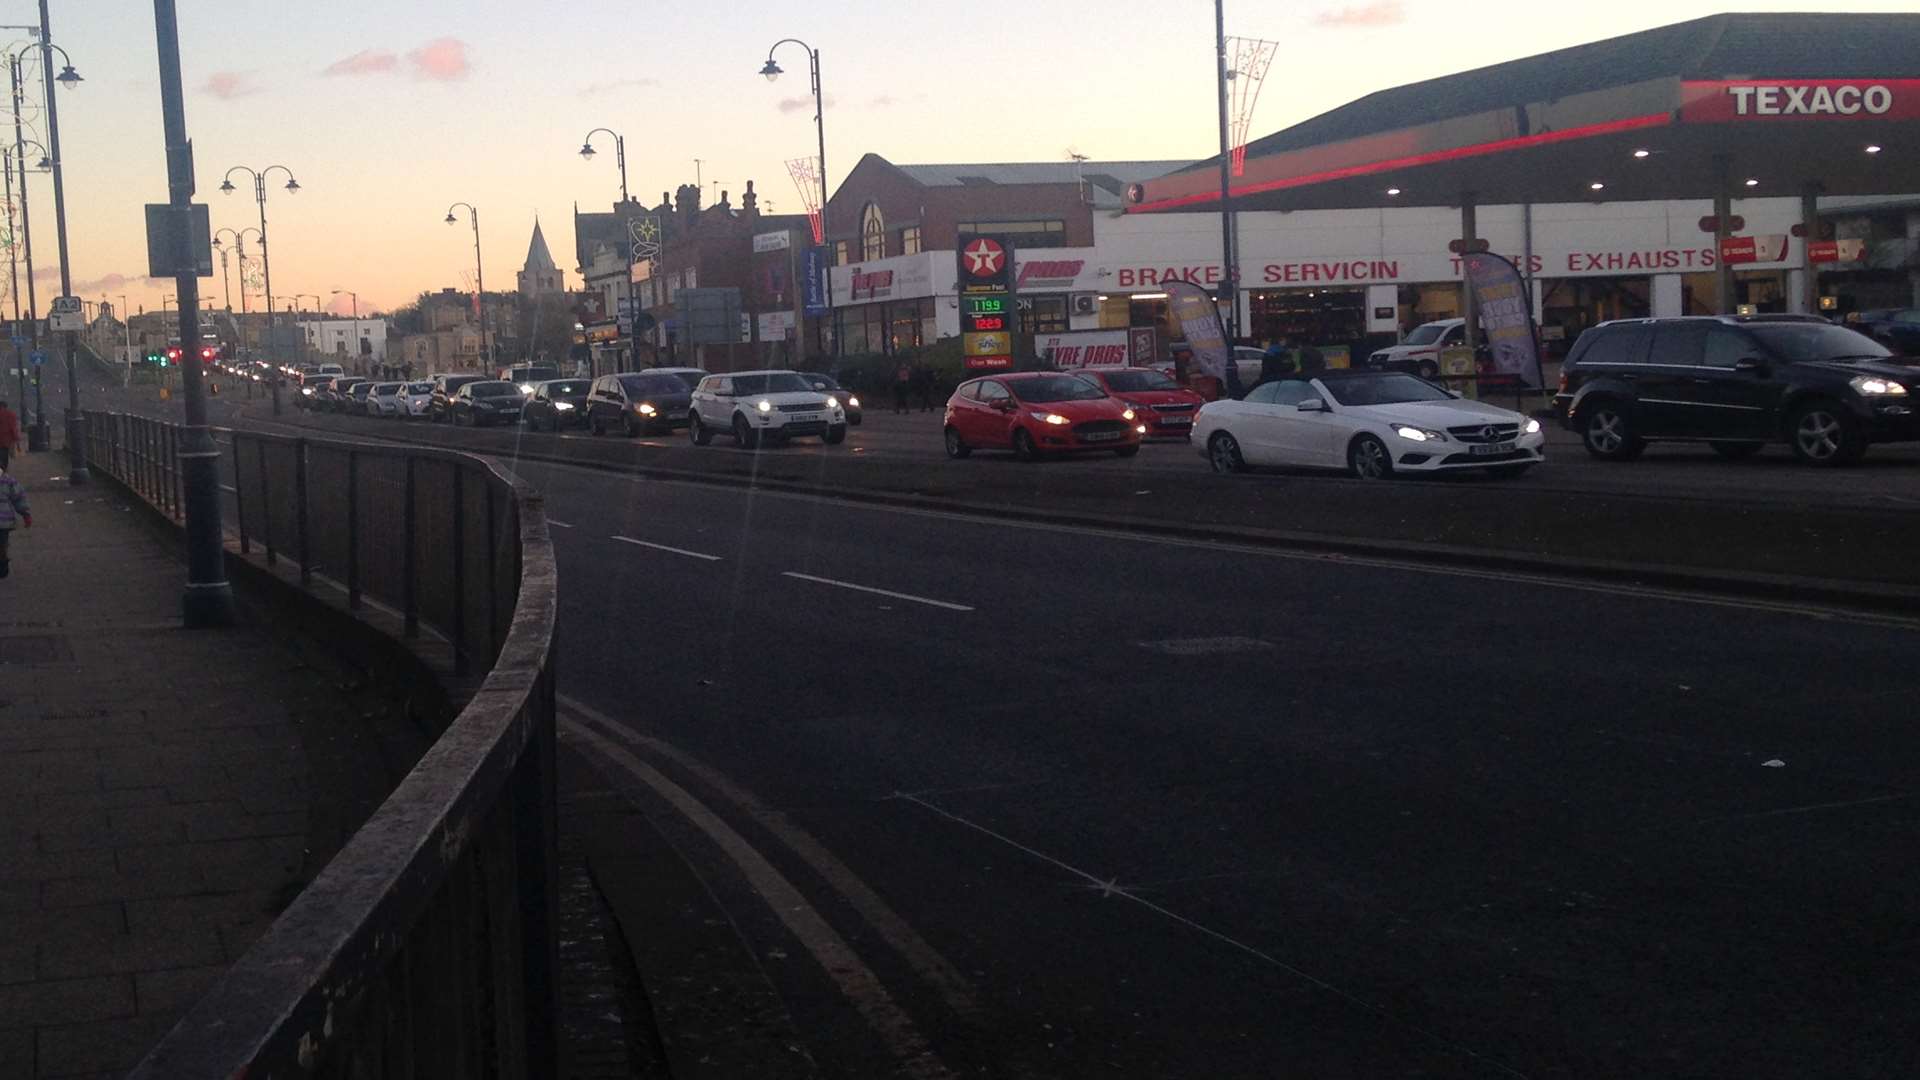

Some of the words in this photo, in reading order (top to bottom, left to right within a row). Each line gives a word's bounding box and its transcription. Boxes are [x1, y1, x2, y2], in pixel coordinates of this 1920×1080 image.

[1728, 85, 1892, 115] TEXACO
[1568, 249, 1715, 271] EXHAUSTS
[1264, 261, 1398, 283] SERVICIN
[58, 300, 78, 310] A2
